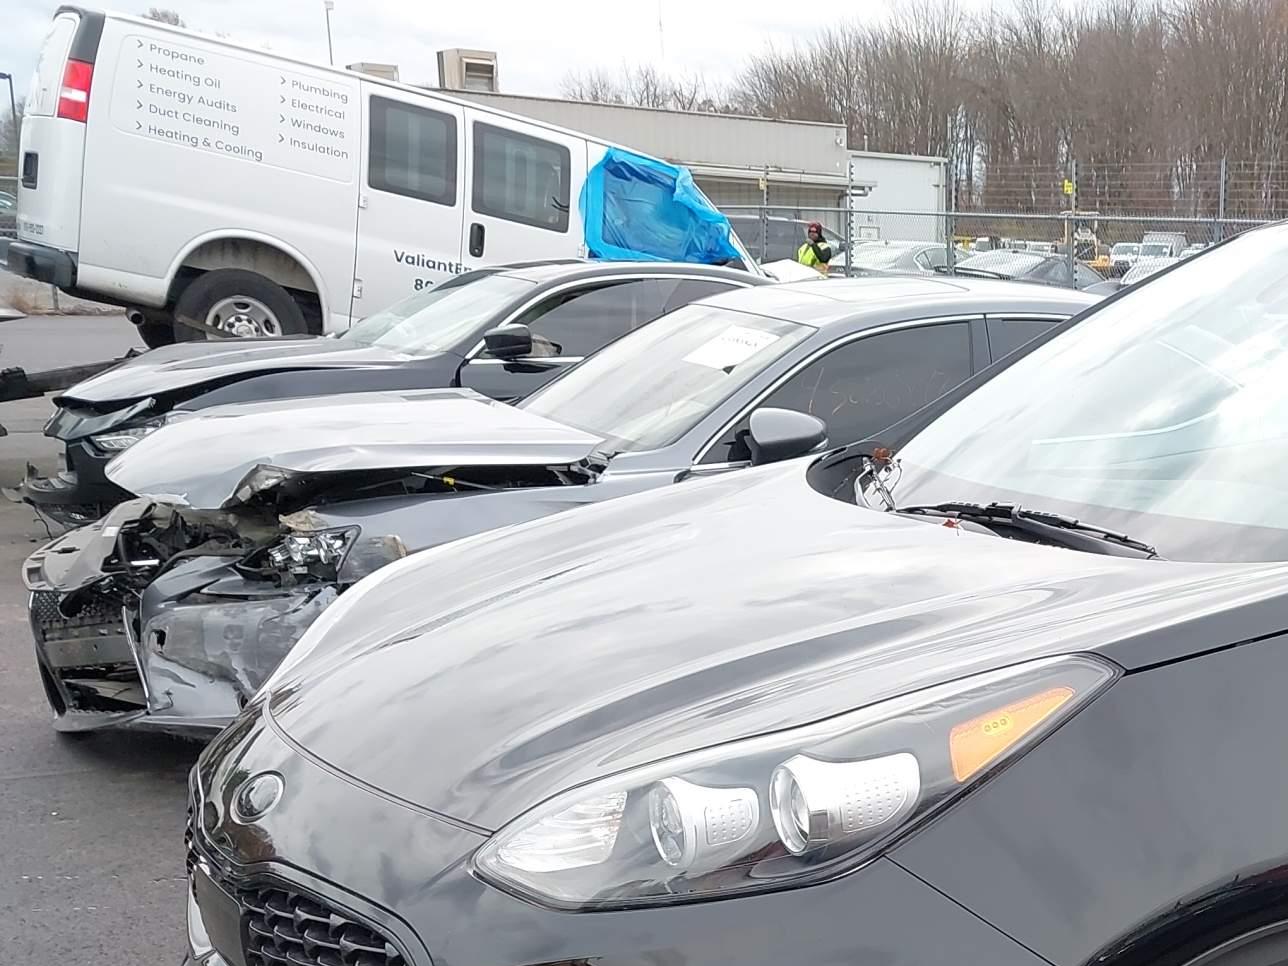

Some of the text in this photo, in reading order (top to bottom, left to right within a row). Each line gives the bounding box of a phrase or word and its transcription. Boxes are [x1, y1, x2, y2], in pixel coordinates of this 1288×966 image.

[150, 43, 205, 65] Propane
[149, 63, 221, 88] Heating Oil
[149, 83, 237, 113] Energy Audits
[291, 79, 349, 104] Plumbing
[149, 103, 240, 136] Duct Cleaning
[291, 98, 345, 120] Electrical
[291, 117, 345, 139] Windows
[148, 124, 263, 162] Heating & Cooling
[289, 137, 349, 160] Insulation
